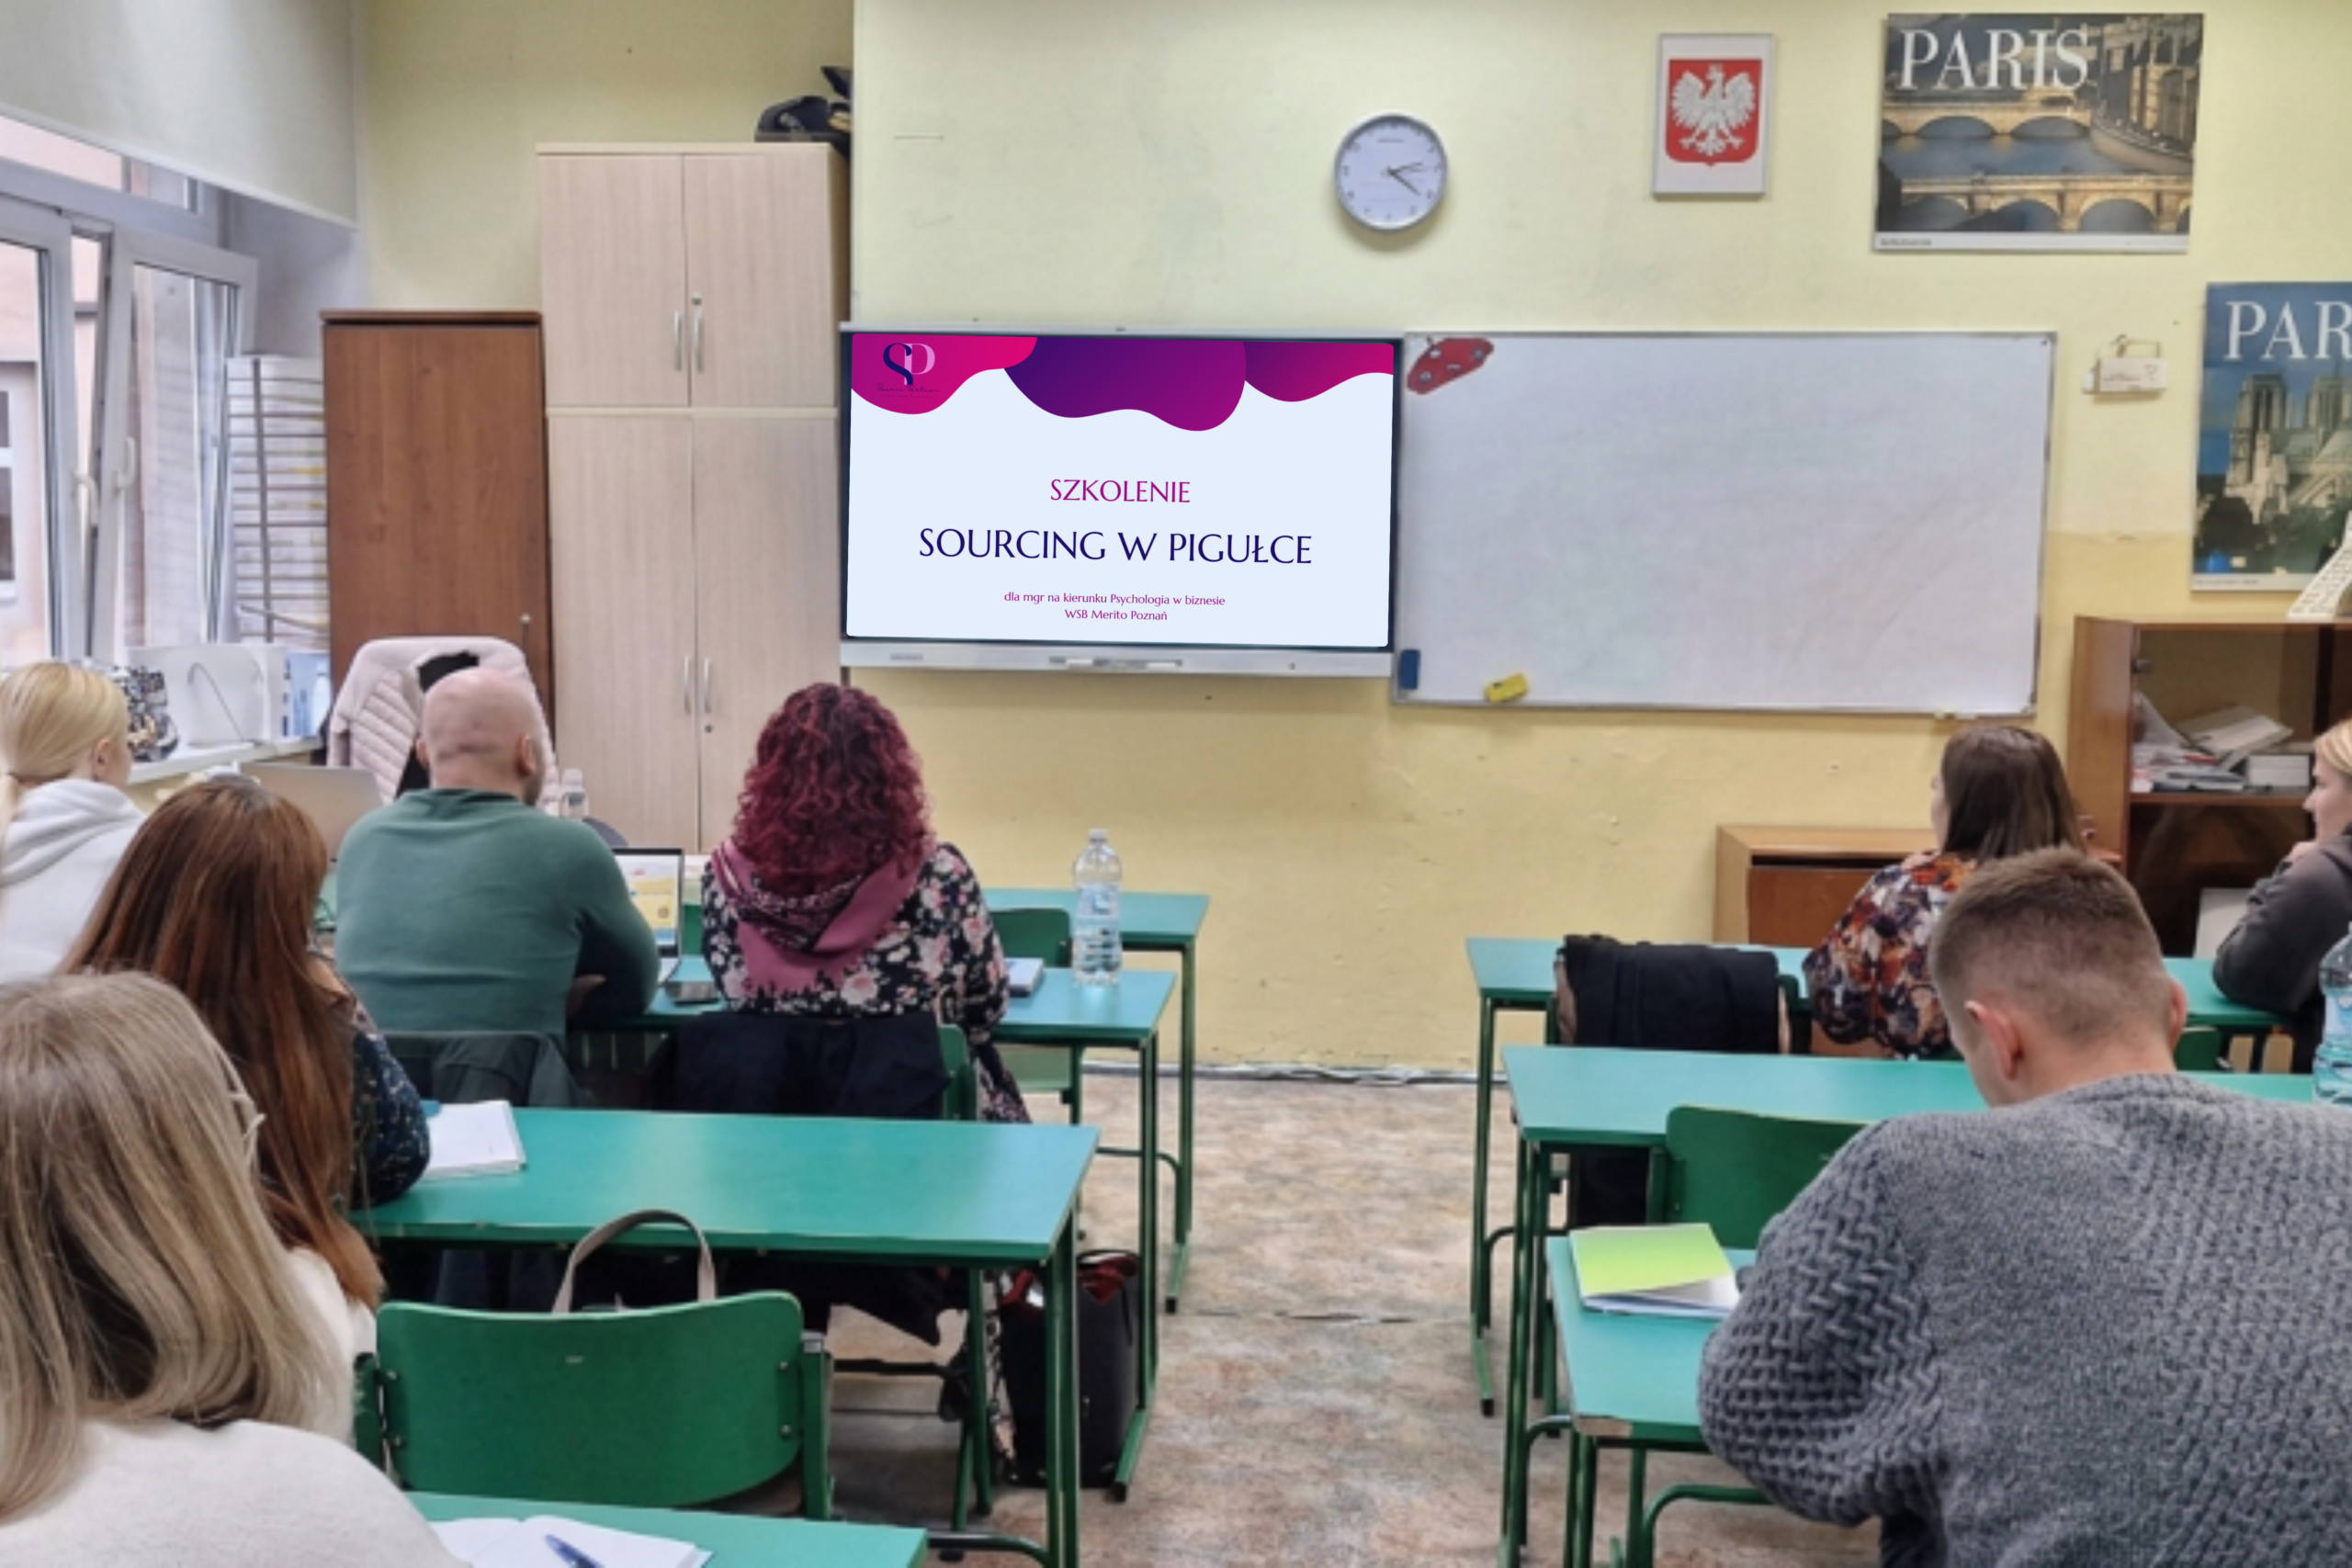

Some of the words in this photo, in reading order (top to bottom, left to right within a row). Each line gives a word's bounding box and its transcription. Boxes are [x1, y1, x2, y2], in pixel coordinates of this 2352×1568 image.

[1895, 28, 2088, 90] PARIS
[2223, 300, 2352, 361] PAR
[1050, 479, 1191, 502] SZKOLENIE
[920, 528, 1106, 560] SOURCING
[1117, 532, 1158, 561] W
[1169, 533, 1312, 564] PIGUŁCE
[1004, 592, 1020, 602] dla
[1023, 593, 1045, 604] mgr
[1047, 594, 1060, 603] na
[1063, 592, 1107, 604] kierunku
[1110, 593, 1170, 607] Psychologia
[1184, 595, 1226, 605] biznesie
[1064, 609, 1089, 619] WSB
[1091, 609, 1128, 620] Merito
[1130, 611, 1168, 621] Poznań
